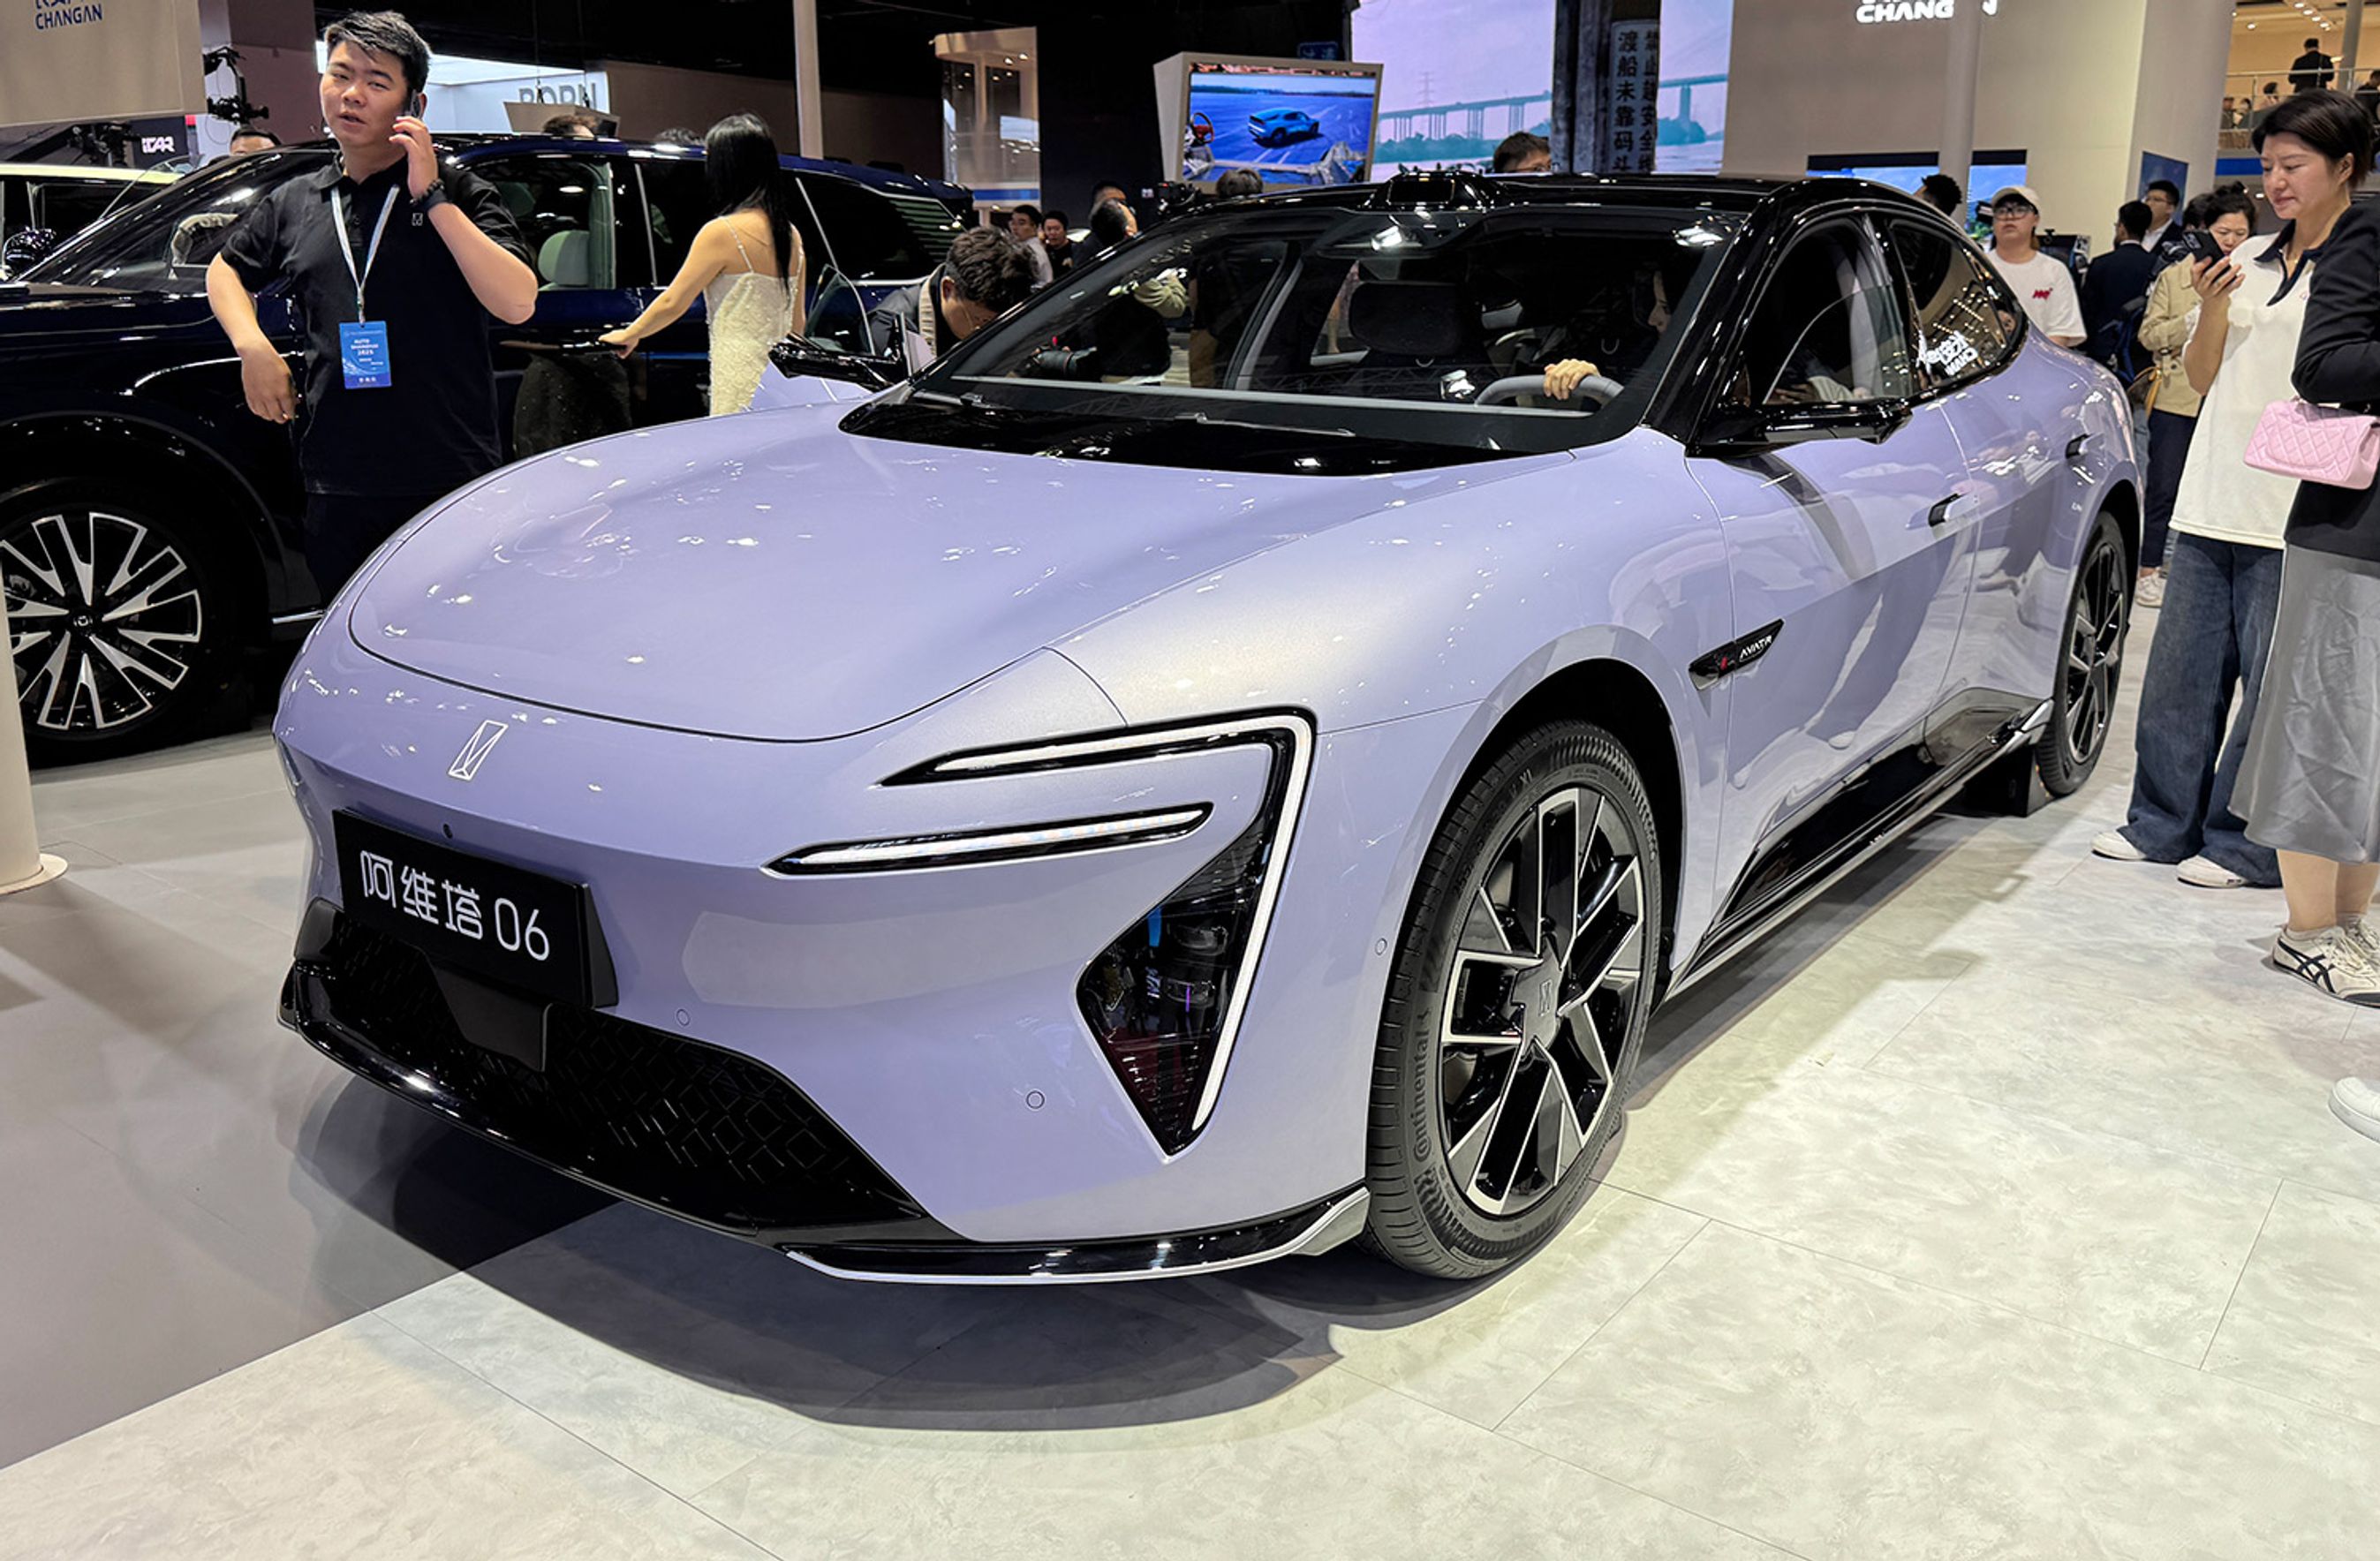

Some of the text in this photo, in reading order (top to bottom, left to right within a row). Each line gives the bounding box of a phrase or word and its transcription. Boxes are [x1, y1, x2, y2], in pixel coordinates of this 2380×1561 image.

[35, 4, 102, 30] CHANGAN
[360, 850, 549, 961] 阿维塔 06
[1410, 1029, 1432, 1162] Continental
